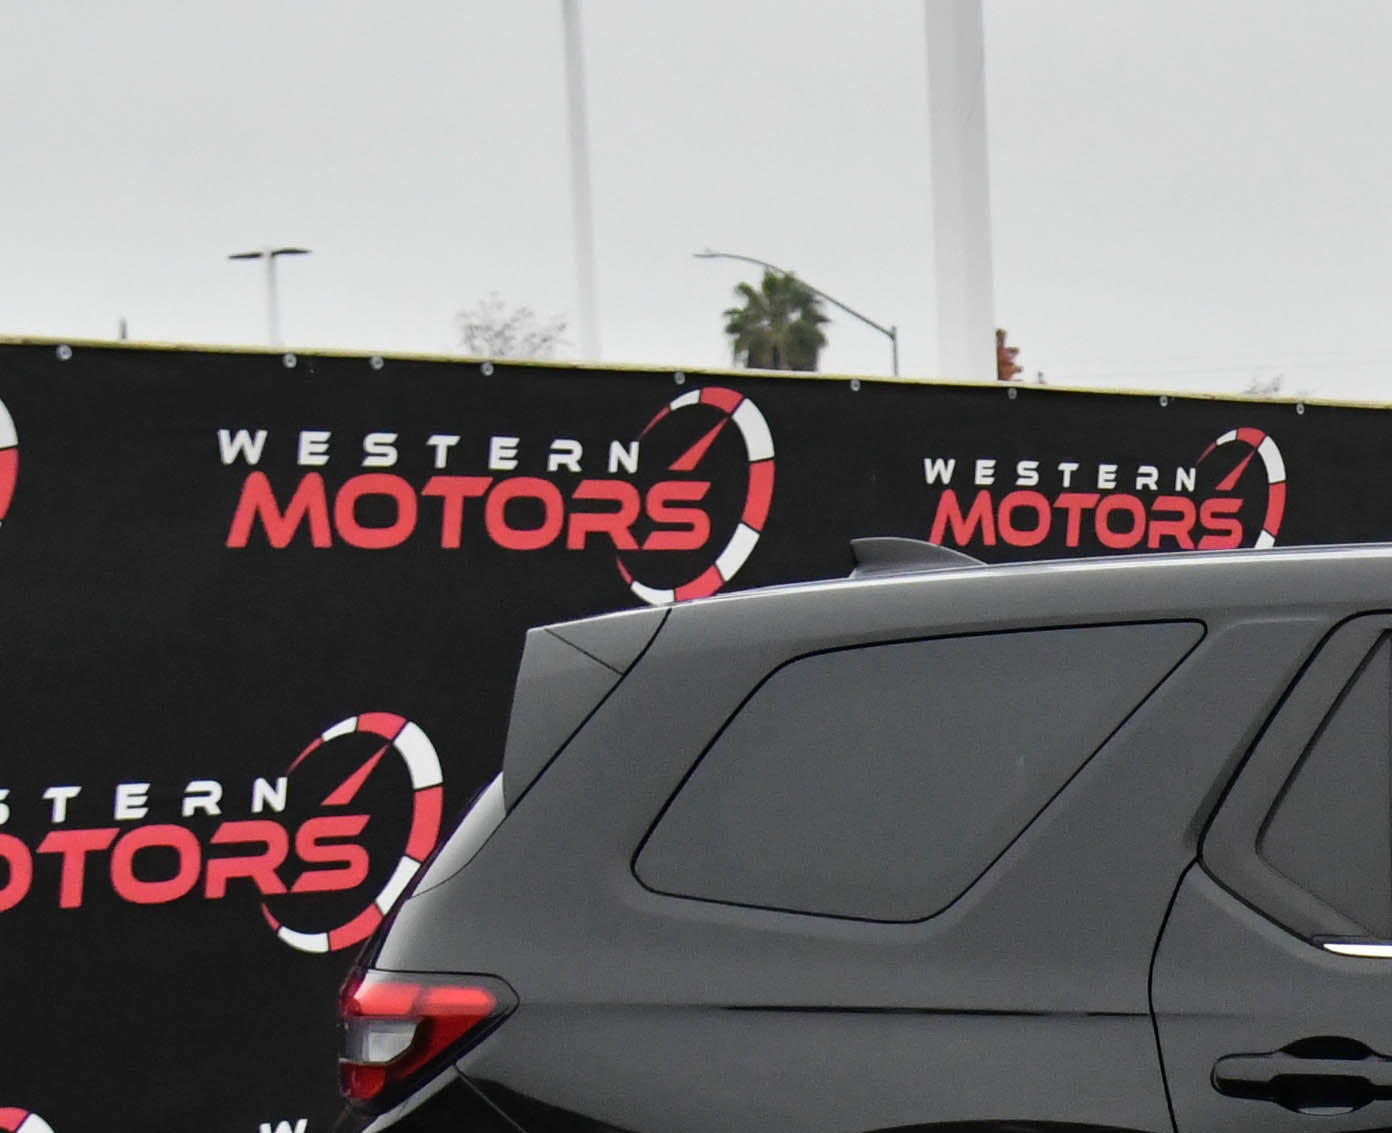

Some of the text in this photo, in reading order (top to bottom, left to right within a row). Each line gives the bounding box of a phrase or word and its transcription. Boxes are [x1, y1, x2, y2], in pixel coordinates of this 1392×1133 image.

[218, 429, 640, 474] WESTERN
[924, 458, 1196, 492] WESTERN
[226, 471, 711, 551] MOTORS
[929, 489, 1243, 551] MOTORS
[0, 776, 288, 825] TERN
